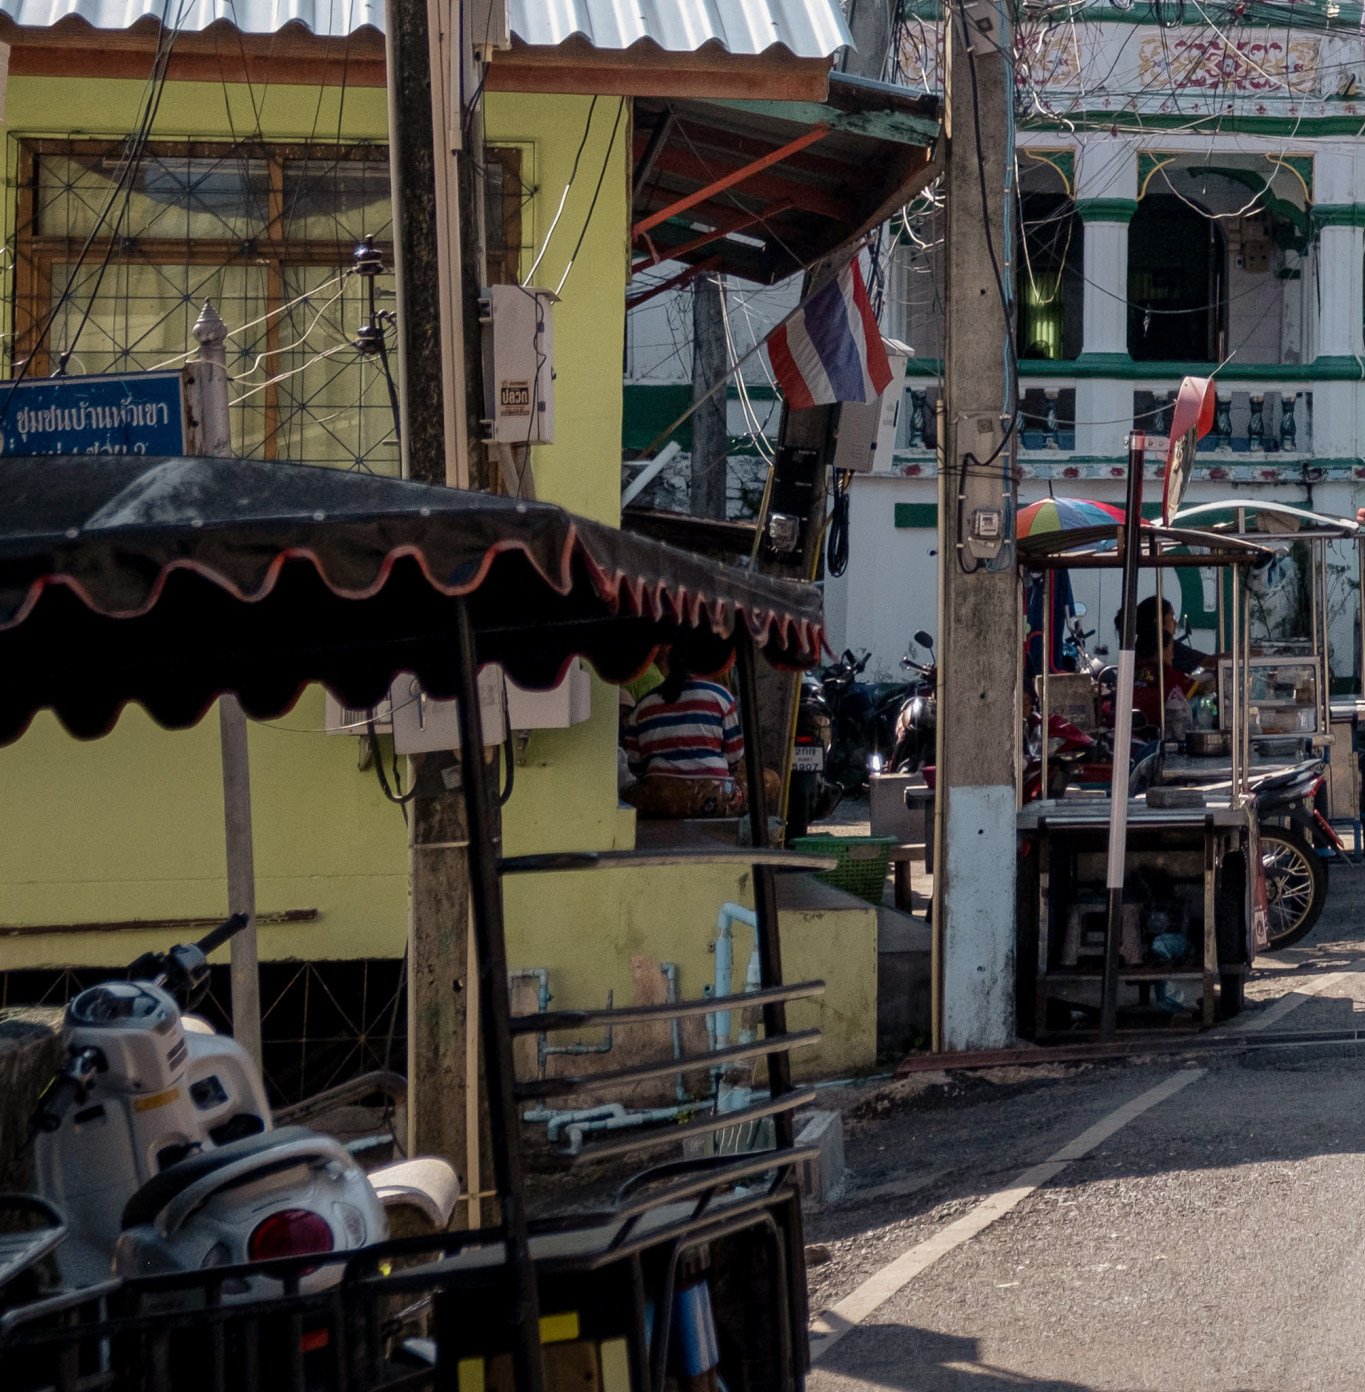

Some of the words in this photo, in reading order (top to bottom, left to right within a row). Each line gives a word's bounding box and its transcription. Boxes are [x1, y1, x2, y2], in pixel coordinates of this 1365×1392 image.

[16, 397, 168, 443] ชุมชนบ้านหัวเขา
